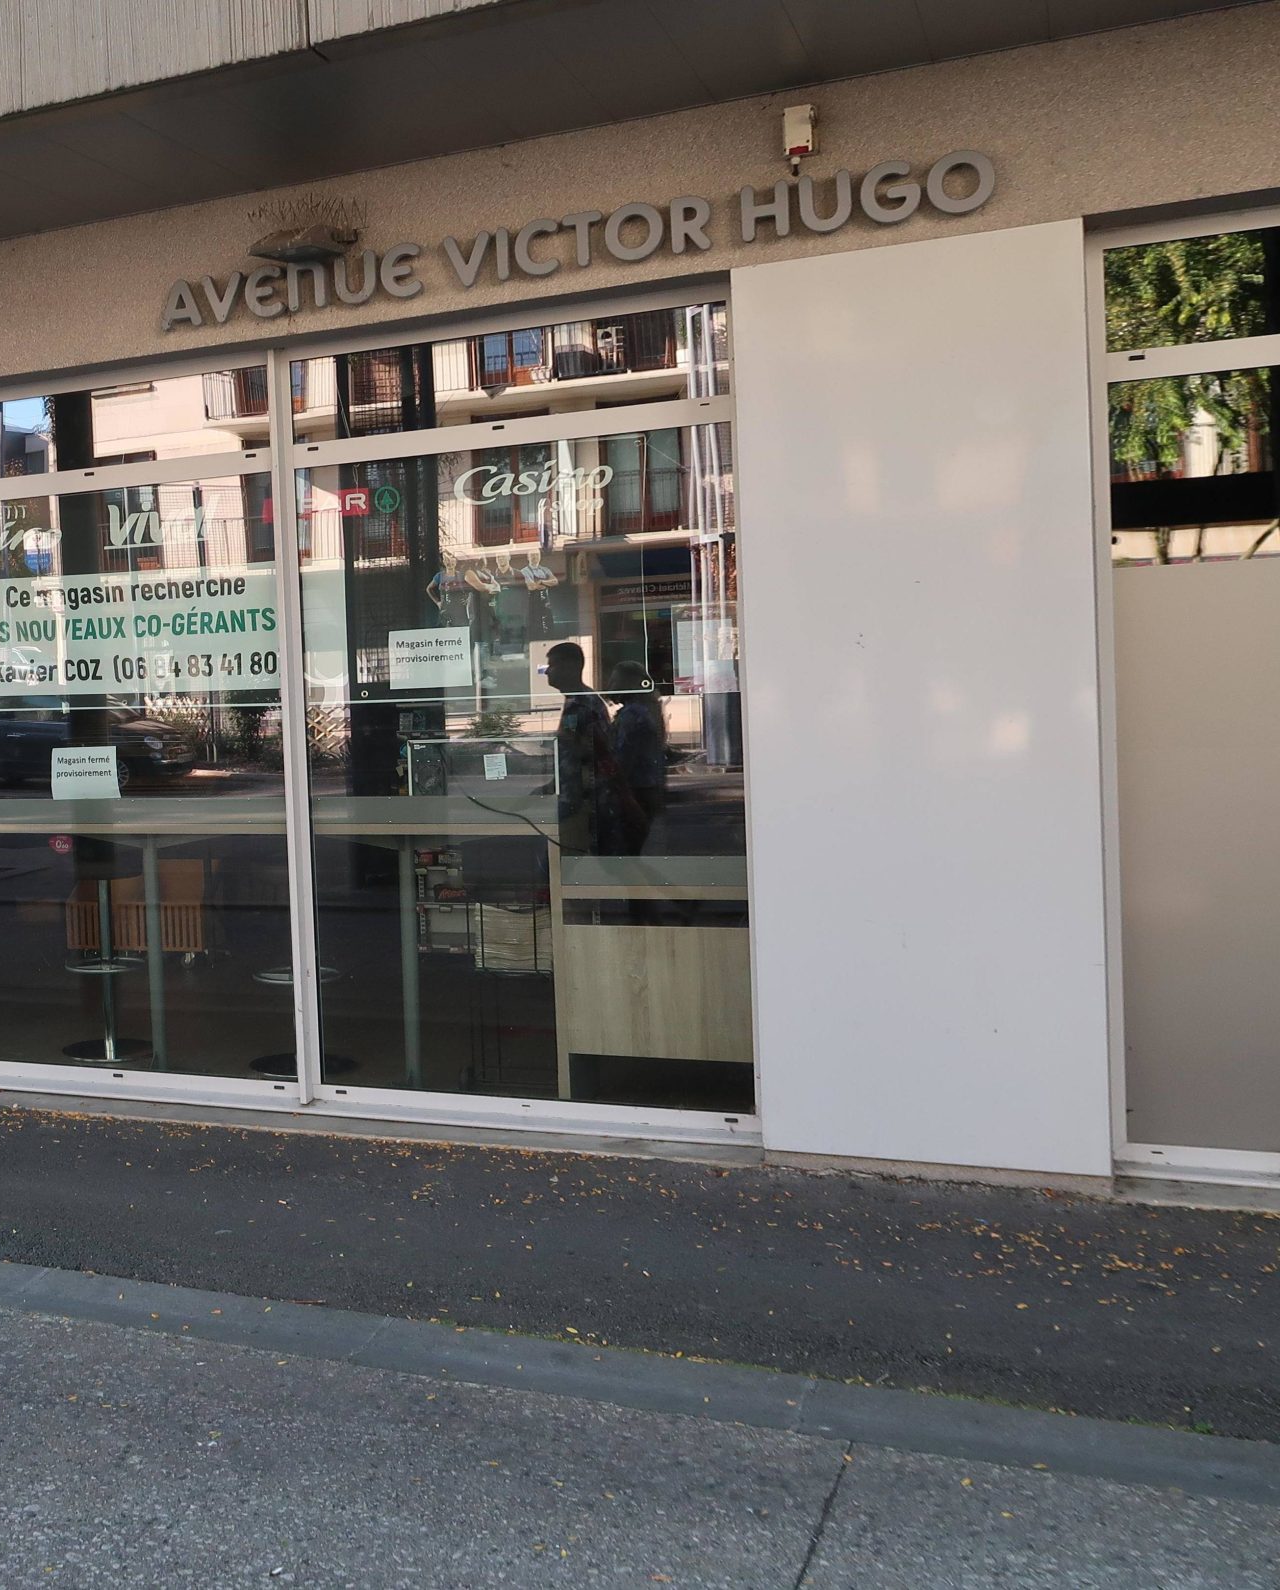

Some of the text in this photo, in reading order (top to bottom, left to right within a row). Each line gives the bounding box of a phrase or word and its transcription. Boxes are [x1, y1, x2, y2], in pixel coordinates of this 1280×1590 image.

[443, 195, 712, 289] VICTOR
[740, 149, 998, 244] HUGO
[453, 459, 614, 506] Casino
[550, 496, 604, 516] sop
[6, 586, 31, 608] Ce
[130, 575, 246, 602] recherche
[134, 606, 276, 638] CO-GÉRANTS
[396, 637, 462, 650] Magasin fermé
[65, 659, 103, 682] COZ
[113, 654, 147, 683] (06
[187, 654, 213, 677] 83
[220, 653, 242, 676] 41
[250, 651, 280, 678] 80
[396, 653, 464, 664] provisoirement
[56, 768, 111, 779] provisoirement
[57, 755, 110, 766] Magasin fermé
